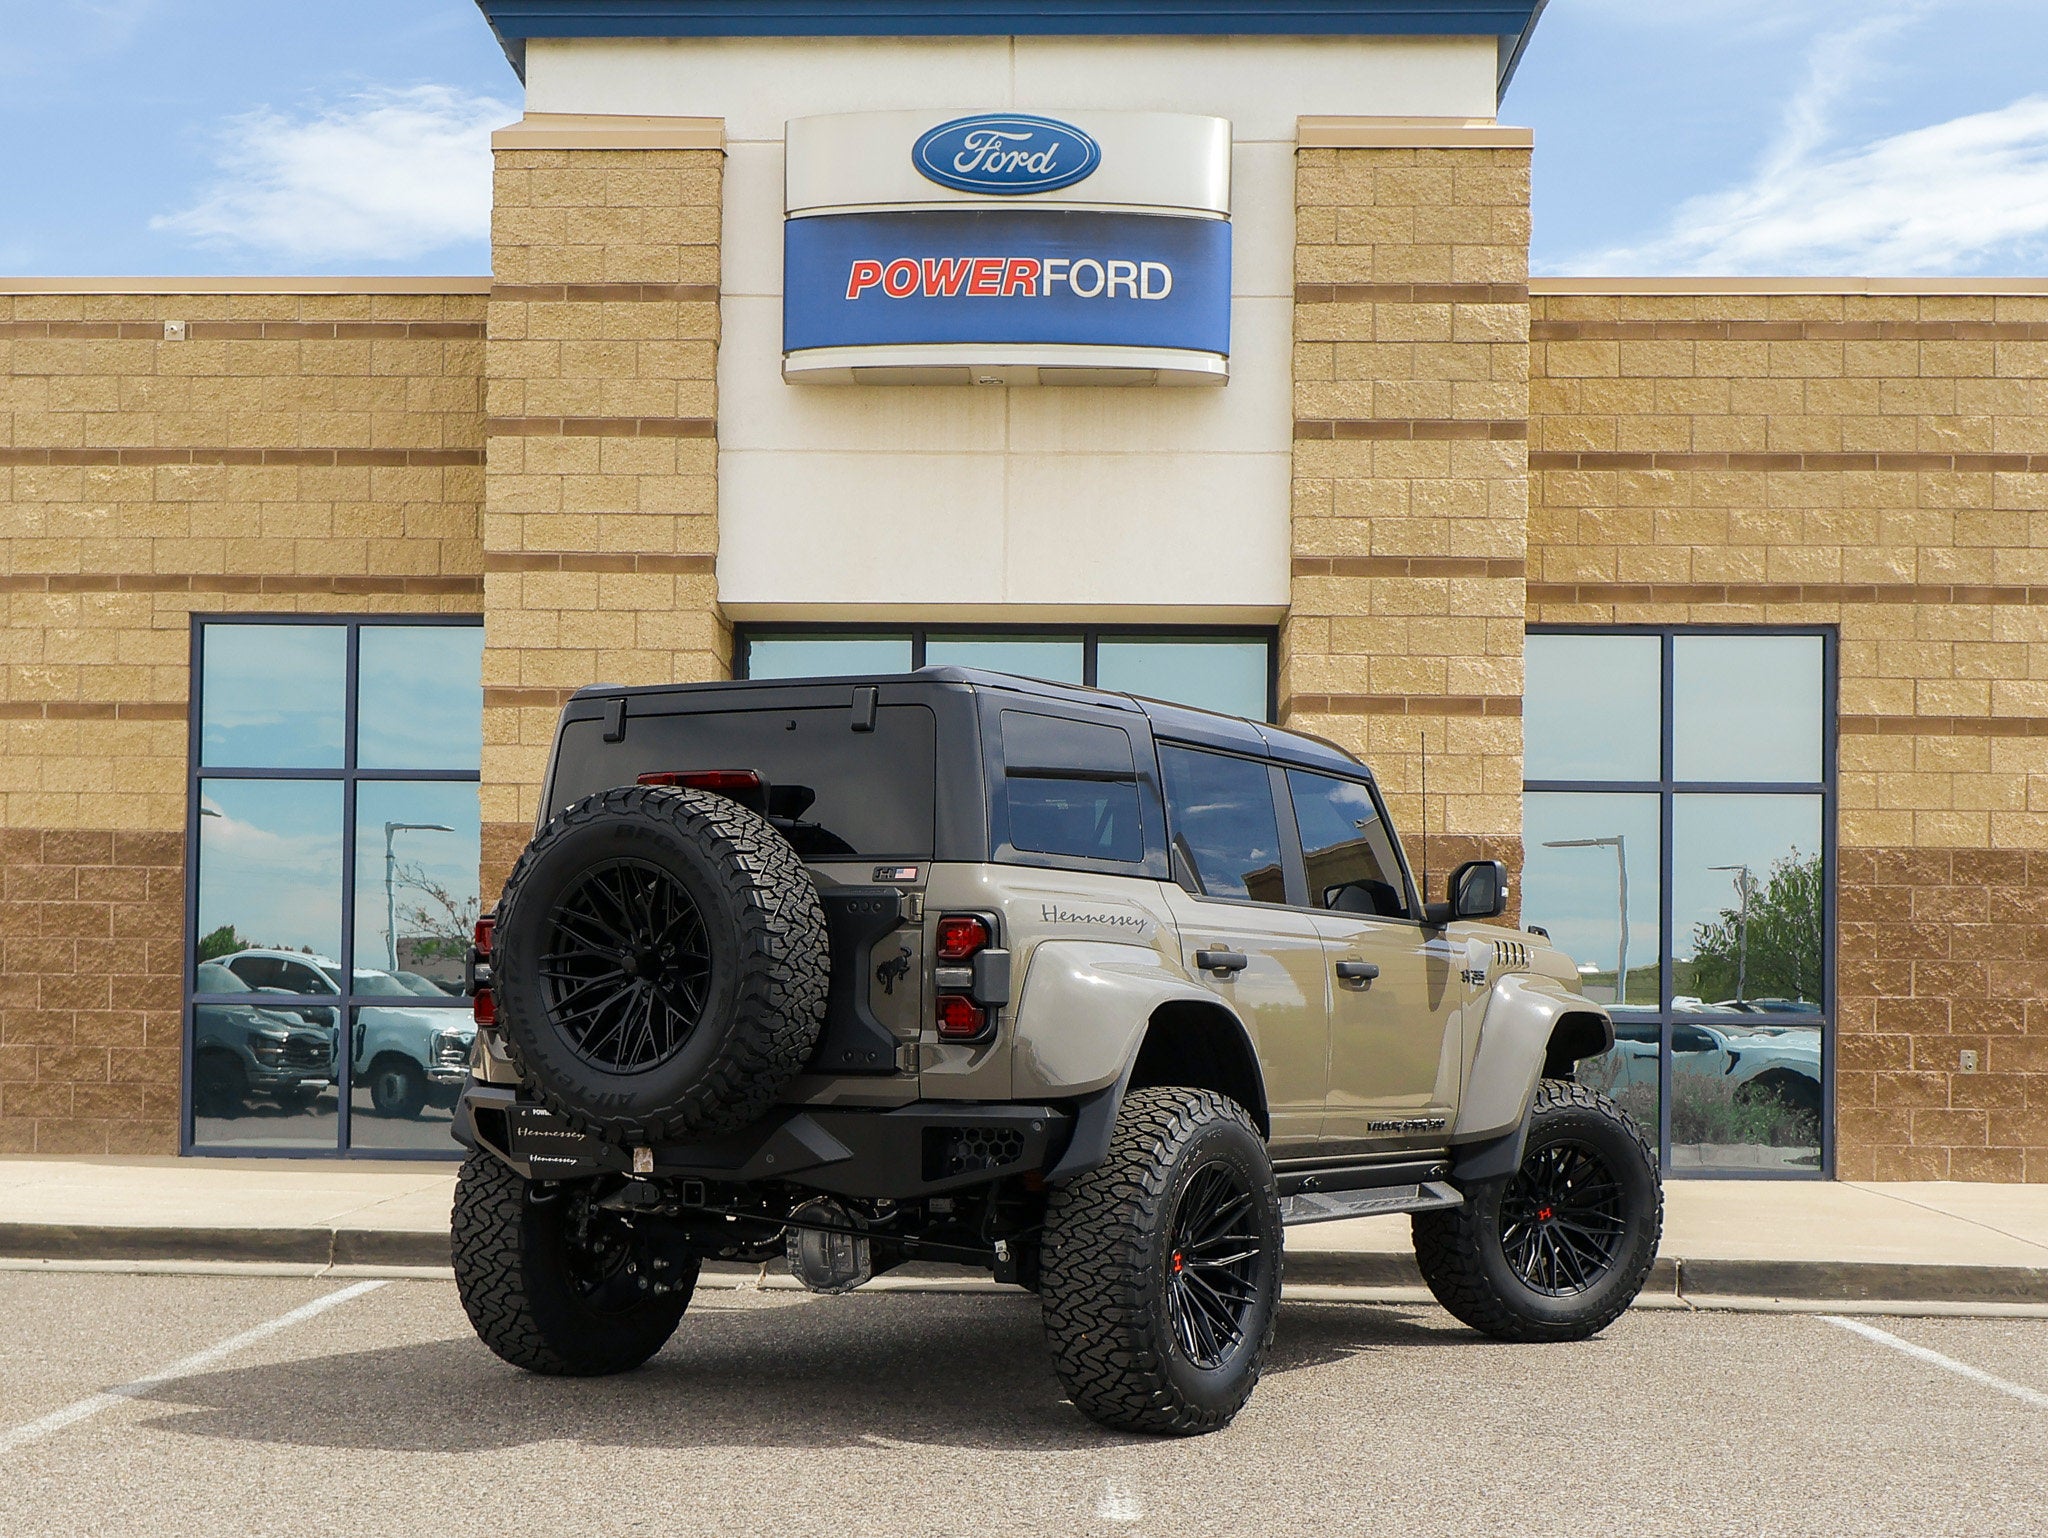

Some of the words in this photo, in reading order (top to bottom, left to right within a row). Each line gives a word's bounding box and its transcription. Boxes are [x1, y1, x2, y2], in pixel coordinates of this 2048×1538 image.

[953, 130, 1059, 175] Ford
[1041, 903, 1150, 934] Hennessey
[517, 1127, 586, 1142] Hennessey
[529, 1154, 578, 1166] Hennessey
